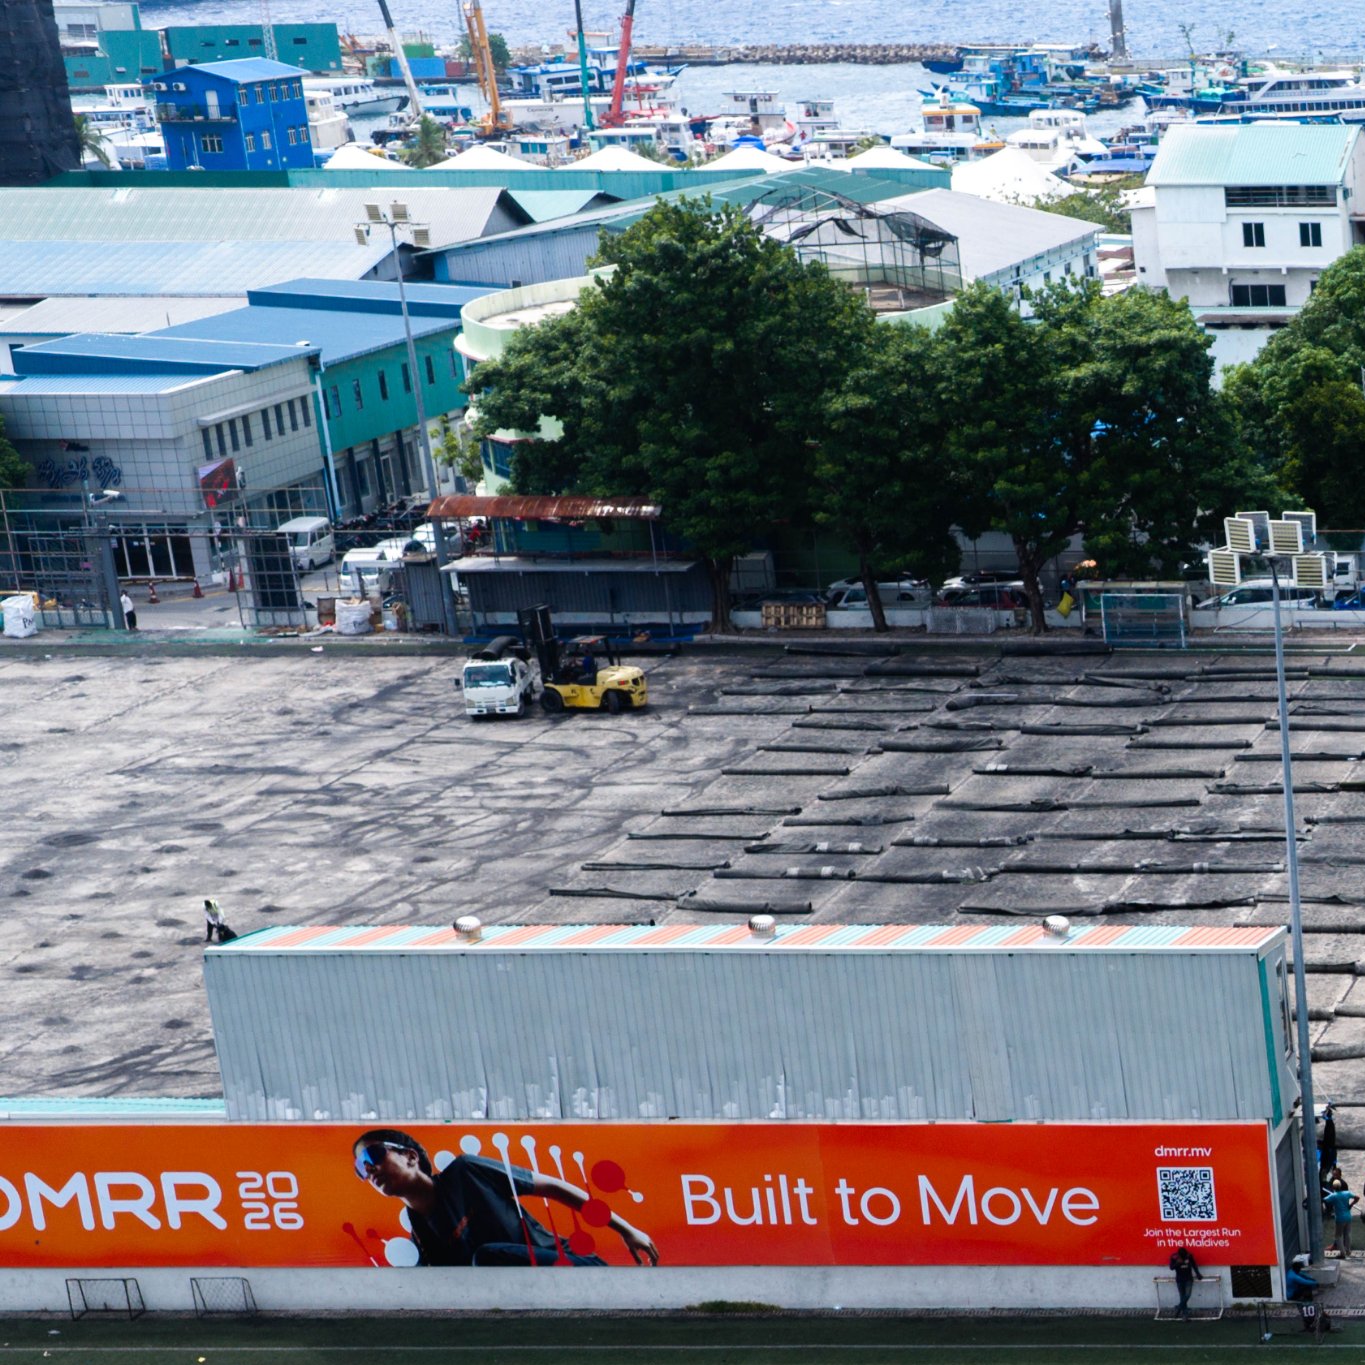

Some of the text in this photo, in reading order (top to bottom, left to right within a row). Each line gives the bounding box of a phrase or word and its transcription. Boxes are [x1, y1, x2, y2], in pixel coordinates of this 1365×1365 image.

[1154, 1145, 1212, 1157] dmrr.mv
[235, 1171, 299, 1199] 20
[680, 1174, 1100, 1226] Built to Move
[241, 1201, 305, 1230] 26
[1143, 1227, 1241, 1239] Join the Largest Run
[1156, 1238, 1230, 1247] in the Maldives
[1302, 1305, 1315, 1318] 10
